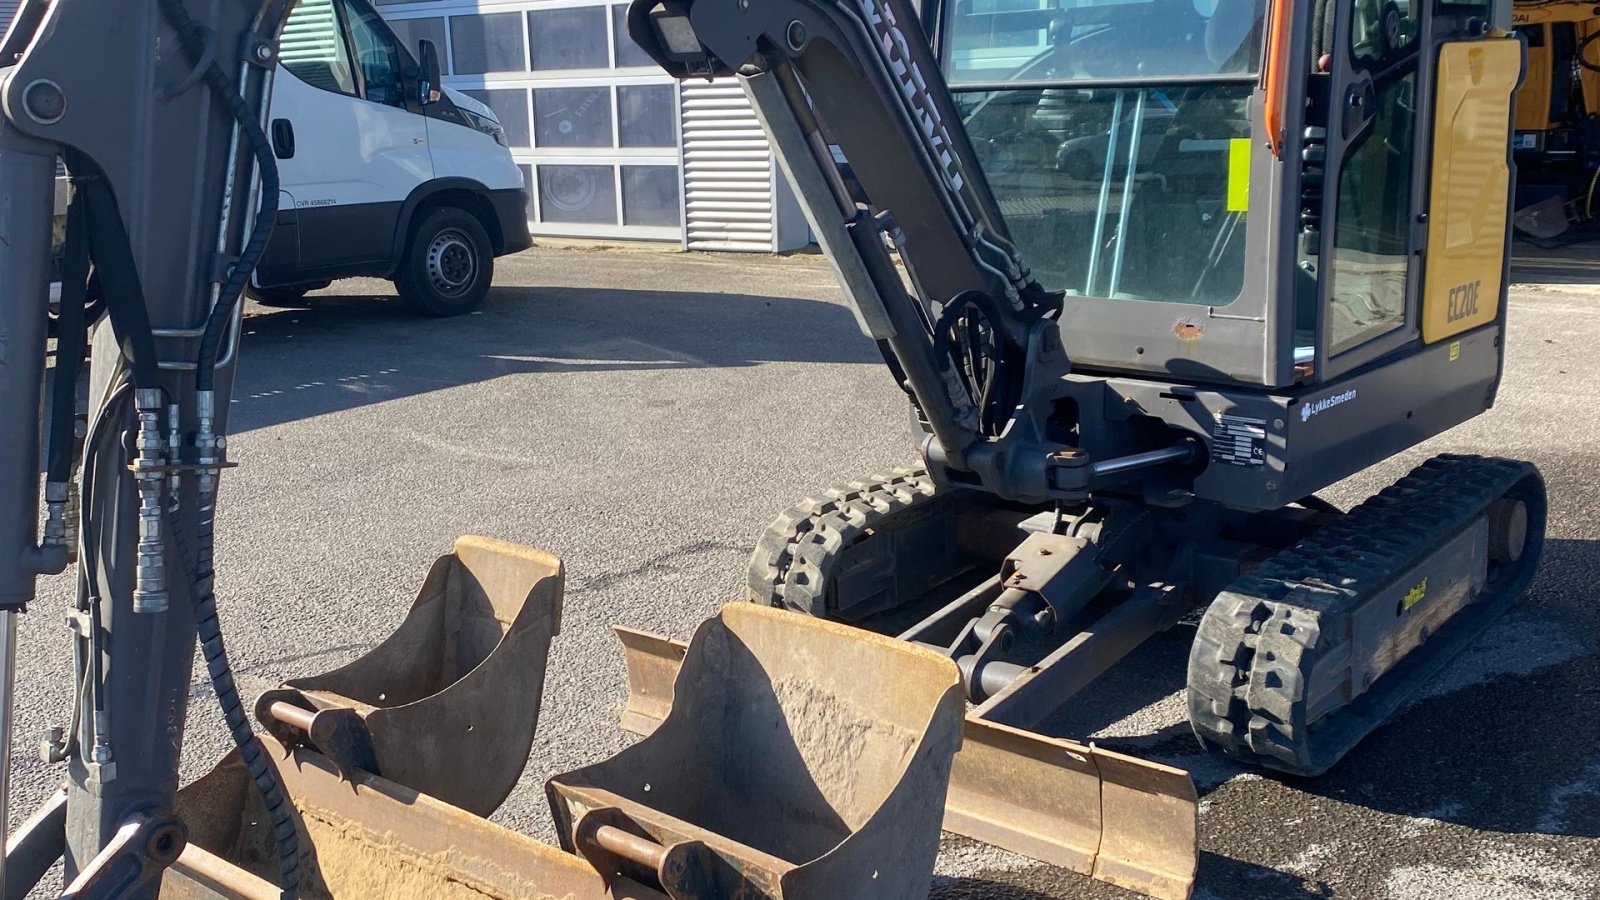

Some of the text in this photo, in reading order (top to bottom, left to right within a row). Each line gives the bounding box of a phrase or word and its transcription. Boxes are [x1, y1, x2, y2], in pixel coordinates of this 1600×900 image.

[296, 200, 310, 208] CVR
[1447, 280, 1481, 323] EC20E
[1311, 390, 1356, 415] LykkeSmeden
